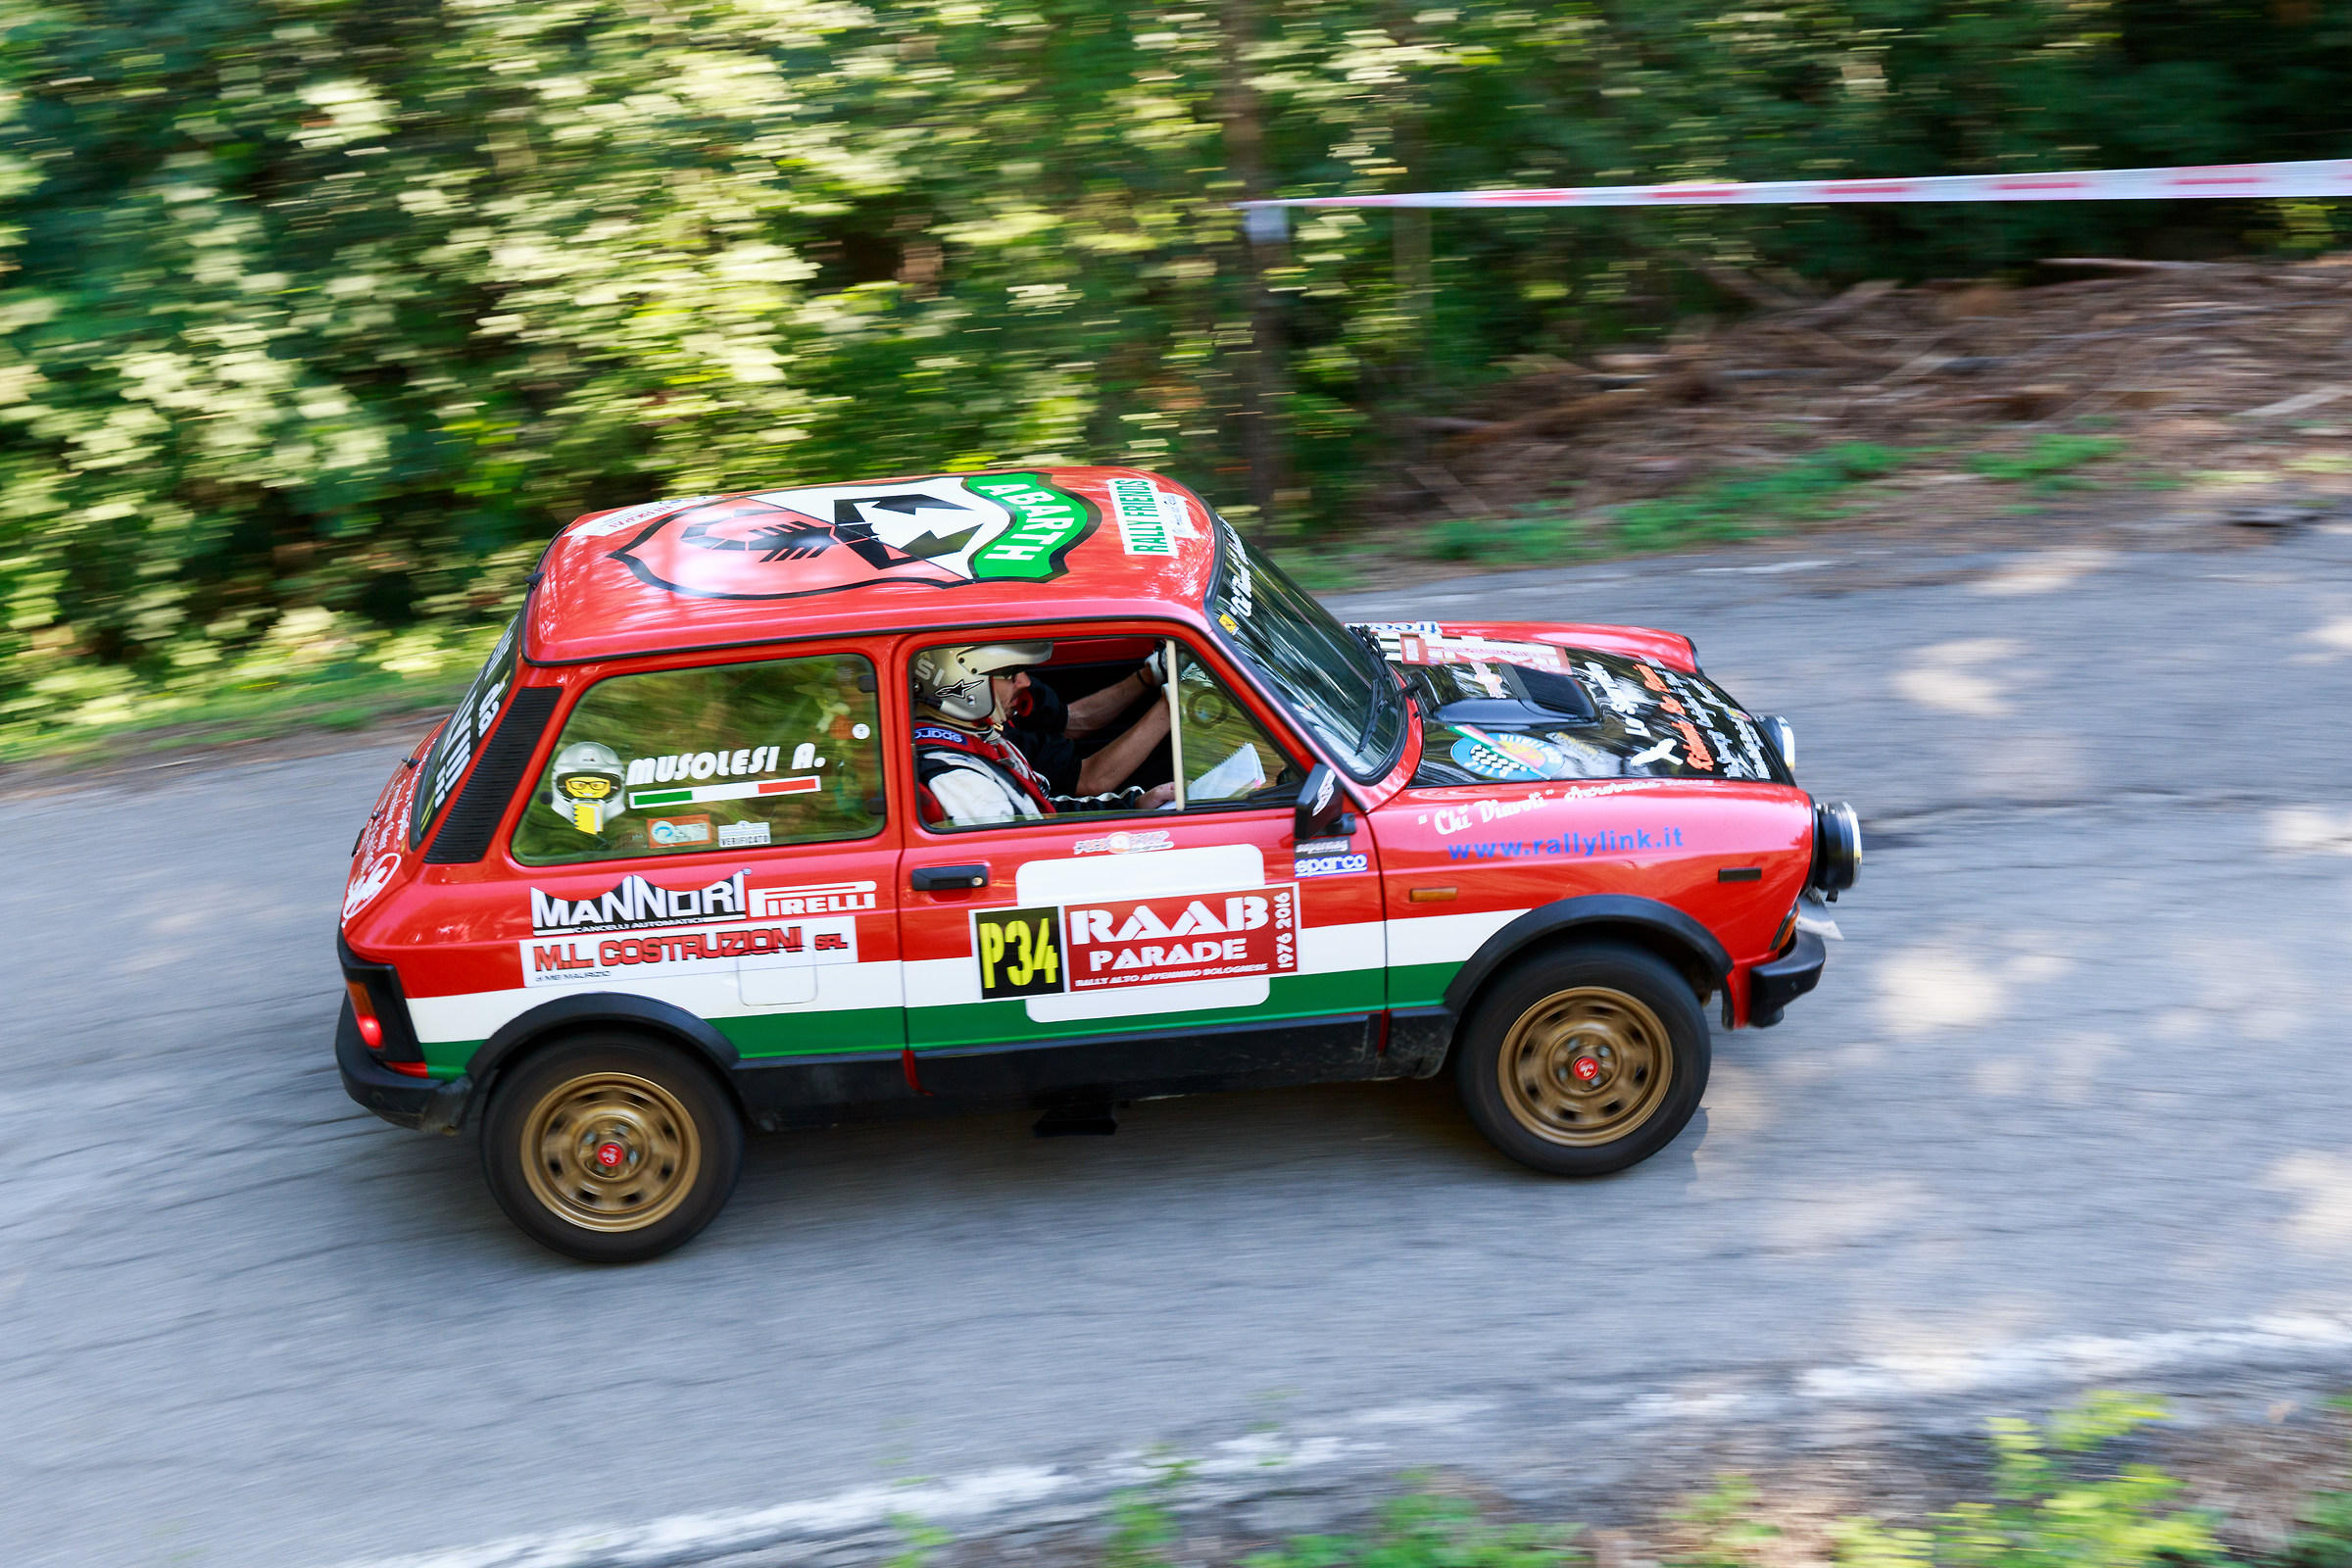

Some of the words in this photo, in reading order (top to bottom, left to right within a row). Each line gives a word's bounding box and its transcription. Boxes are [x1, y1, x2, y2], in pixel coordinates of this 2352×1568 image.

[1113, 479, 1159, 517] FRIENDS
[977, 484, 1075, 561] ABARTH
[1125, 519, 1169, 553] RALLY
[914, 727, 963, 744] sparc
[626, 746, 780, 785] MUSOLESI
[791, 742, 826, 770] A.
[1447, 827, 1684, 859] www.rallylink.it
[1295, 855, 1367, 876] sparco
[530, 869, 746, 928] MANNORI
[748, 881, 877, 917] PIRELLI
[1273, 892, 1293, 930] 2016
[573, 923, 630, 934] CANCELLI
[1070, 896, 1269, 945] RAAB
[600, 927, 804, 966] COSTRUZIONI
[814, 933, 849, 951] SRL
[979, 917, 1058, 988] P34
[1089, 937, 1248, 972] PARADE
[1275, 932, 1295, 968] 1976
[1075, 976, 1109, 987] RALLY
[1109, 974, 1140, 984] ALTO
[1202, 962, 1269, 976] BOLOGNESE
